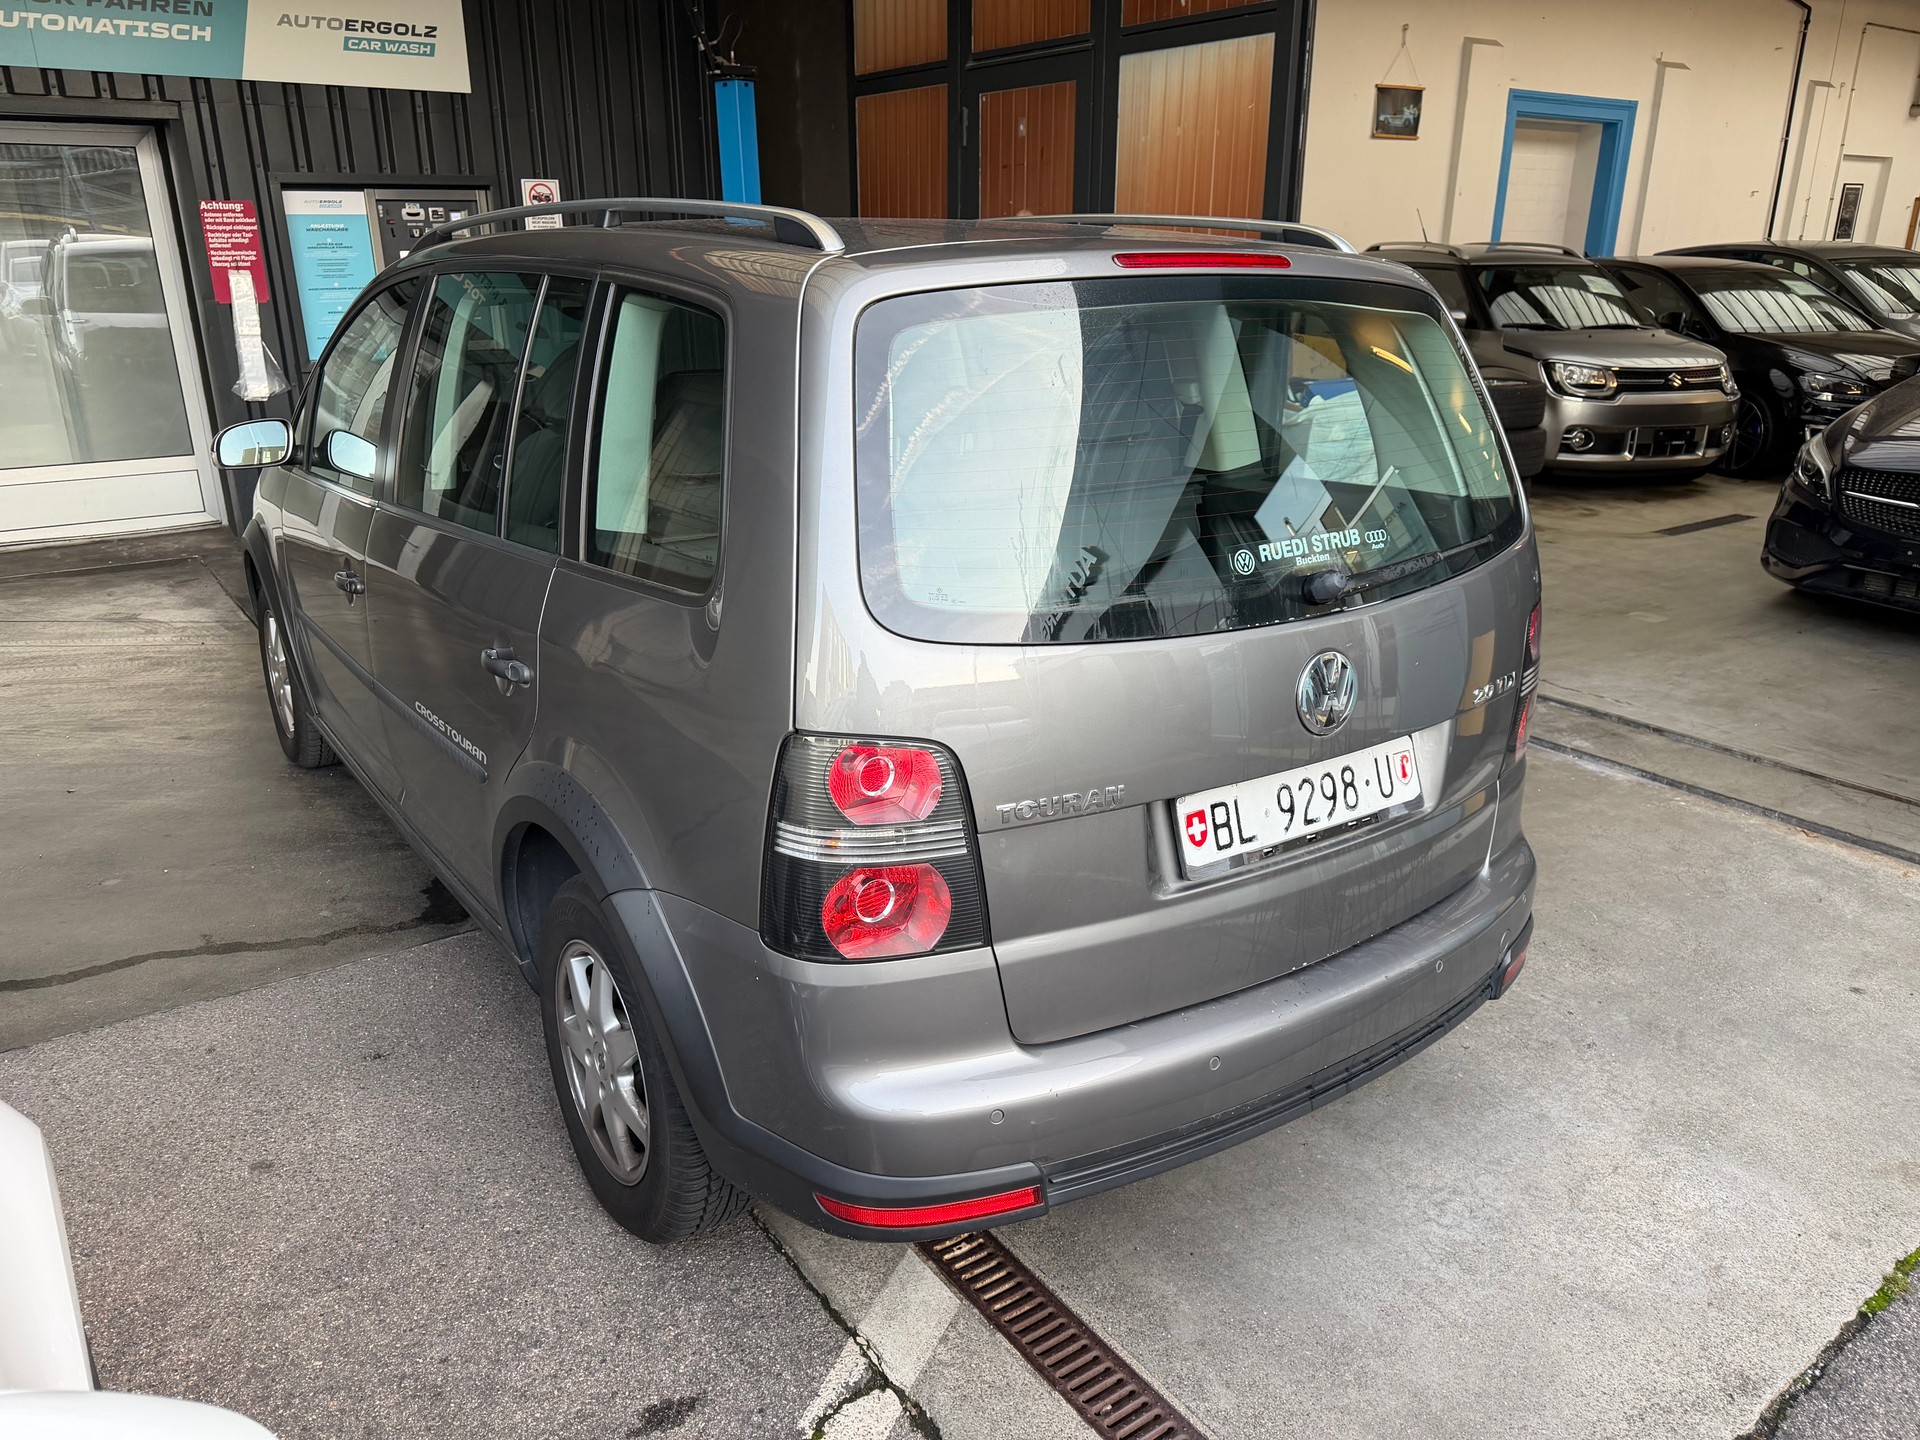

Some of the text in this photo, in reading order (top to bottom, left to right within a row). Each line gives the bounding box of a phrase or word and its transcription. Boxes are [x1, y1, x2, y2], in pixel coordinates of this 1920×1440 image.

[276, 13, 438, 39] AUTOERGOLZ
[347, 39, 431, 55] CAR WASH
[200, 201, 244, 212] Achtung:
[1258, 528, 1361, 562] RUEDI STRUB
[1296, 552, 1330, 566] Buckten
[996, 784, 1125, 824] TOURAN
[1210, 799, 1258, 851] BL
